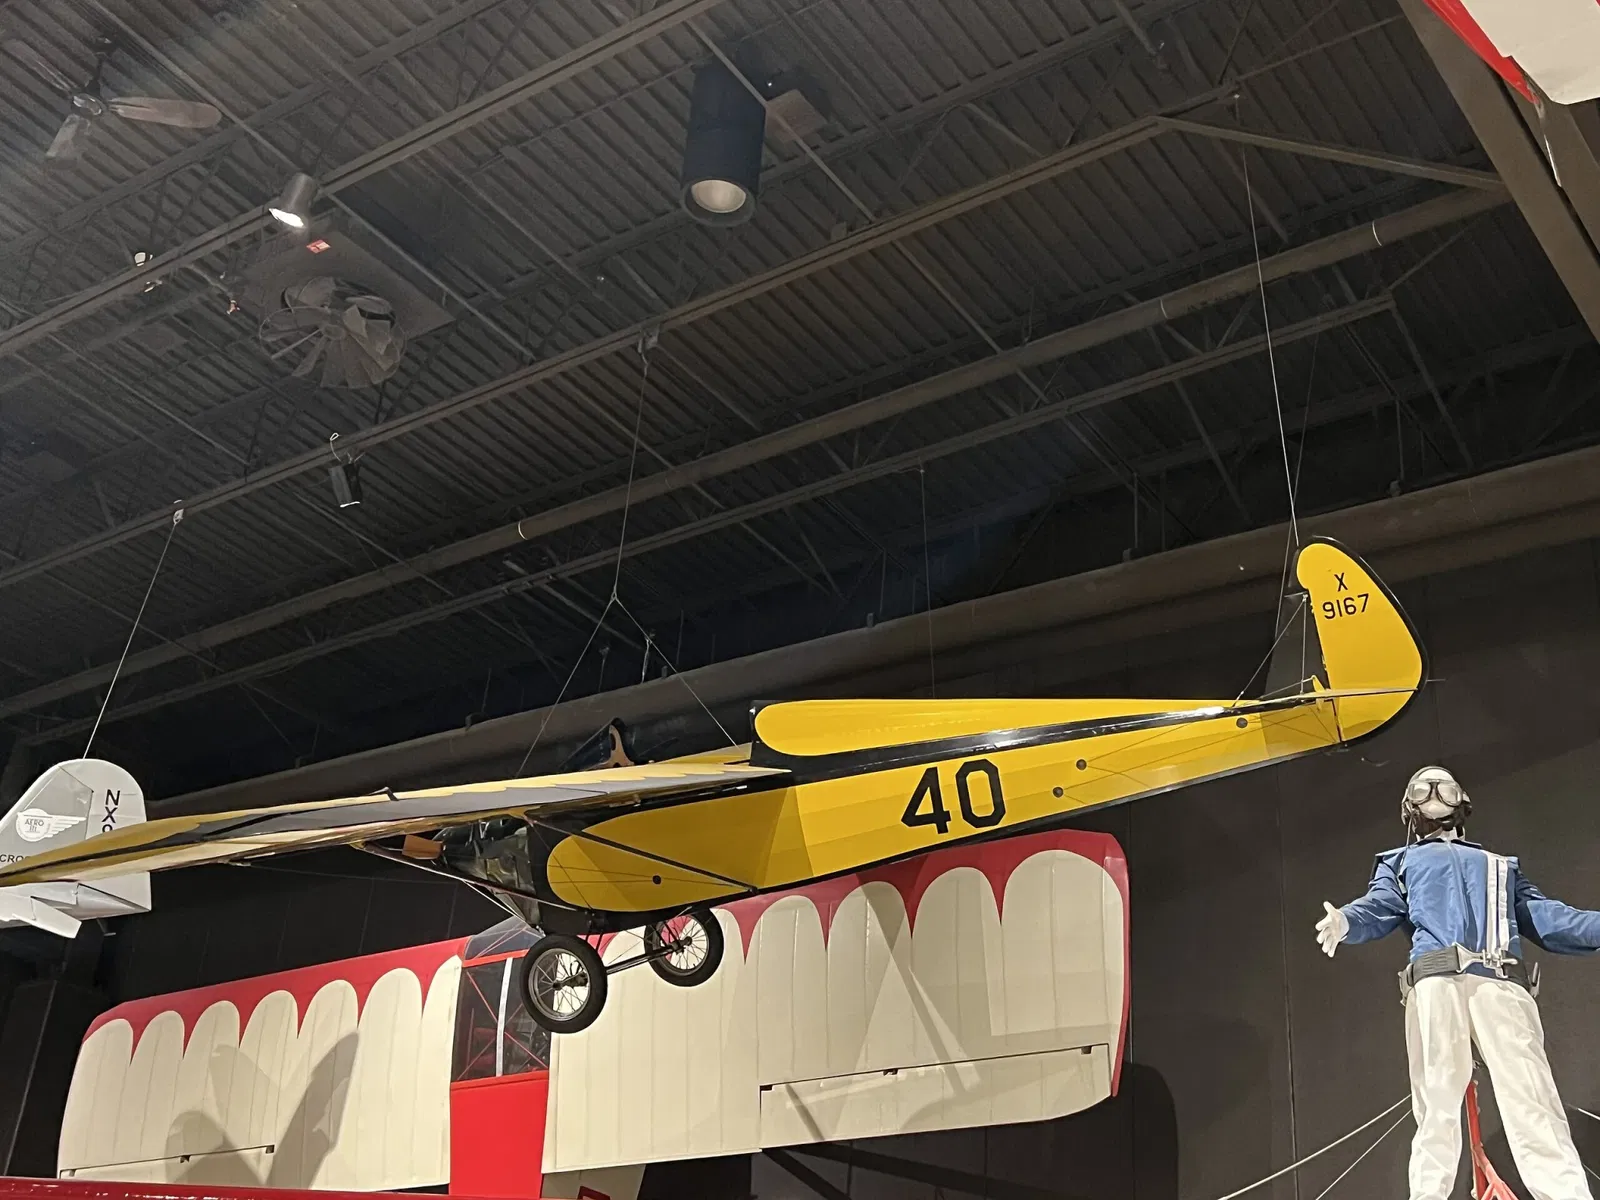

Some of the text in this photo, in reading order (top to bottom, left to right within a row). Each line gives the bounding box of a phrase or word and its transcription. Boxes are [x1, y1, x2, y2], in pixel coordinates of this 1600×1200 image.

[1334, 572, 1348, 592] X
[1322, 593, 1369, 619] 9167
[900, 758, 1006, 834] 40
[24, 818, 45, 827] AERO
[0, 853, 31, 863] CRO
